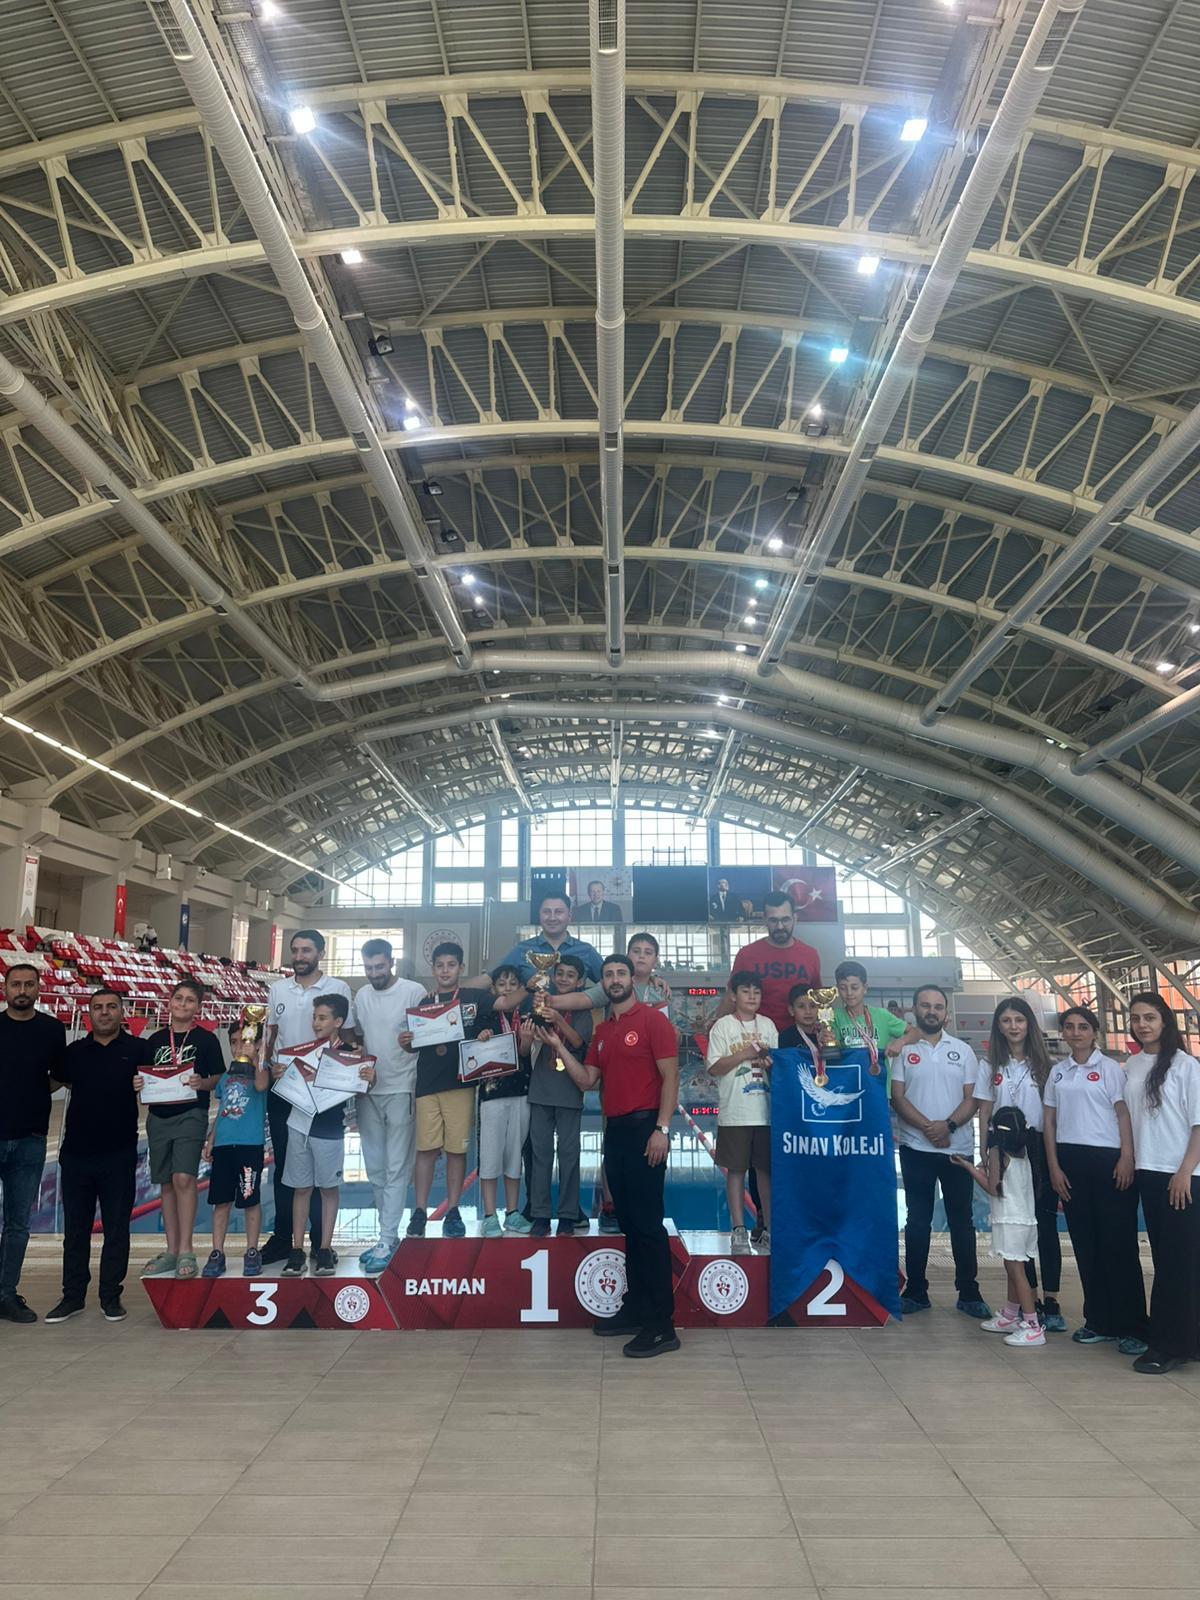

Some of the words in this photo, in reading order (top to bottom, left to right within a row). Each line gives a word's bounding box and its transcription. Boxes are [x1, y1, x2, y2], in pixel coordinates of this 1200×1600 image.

[753, 961, 809, 980] USPA
[782, 1131, 829, 1157] SINAV
[404, 1278, 486, 1297] BATMAN
[520, 1249, 559, 1323] 1
[806, 1258, 847, 1316] 2
[245, 1282, 279, 1326] 3
